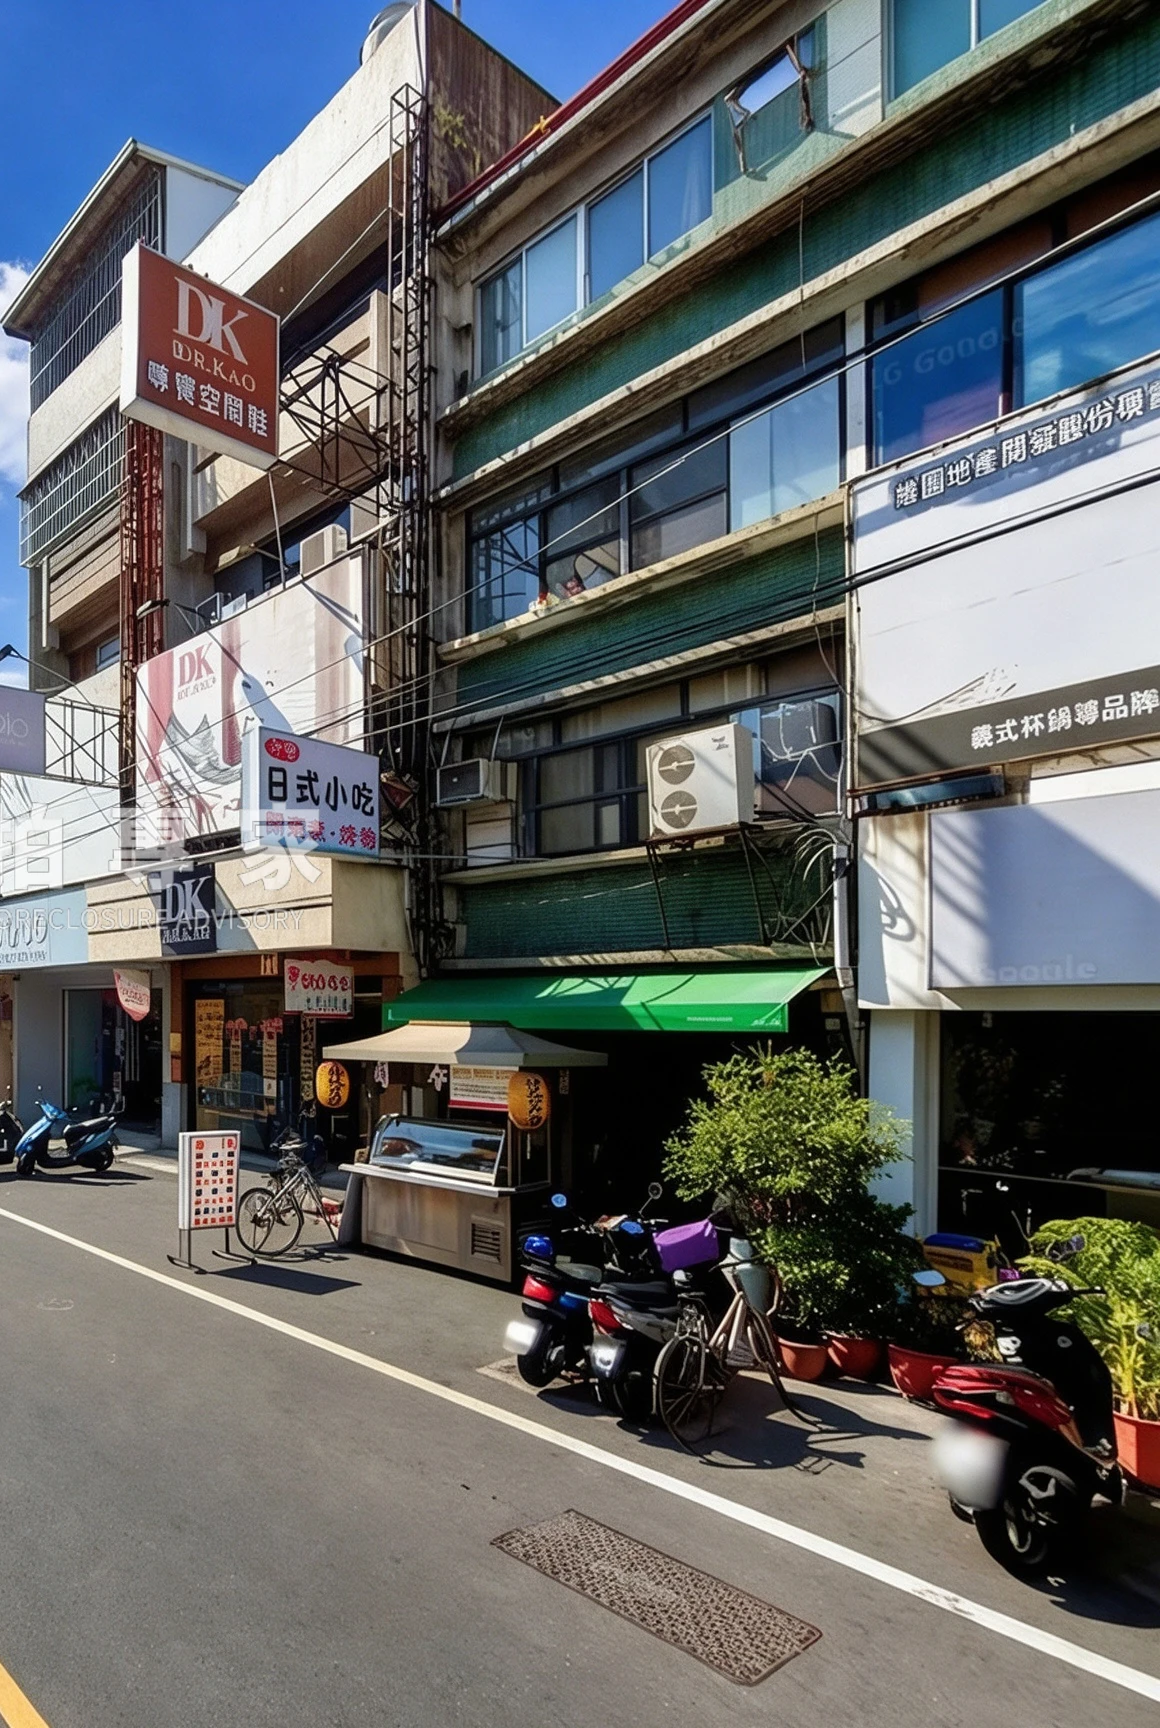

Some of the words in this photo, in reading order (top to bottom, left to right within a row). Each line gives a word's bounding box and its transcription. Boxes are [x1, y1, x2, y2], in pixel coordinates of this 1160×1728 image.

[173, 276, 249, 365] DK
[268, 766, 374, 817] 日式小吃
